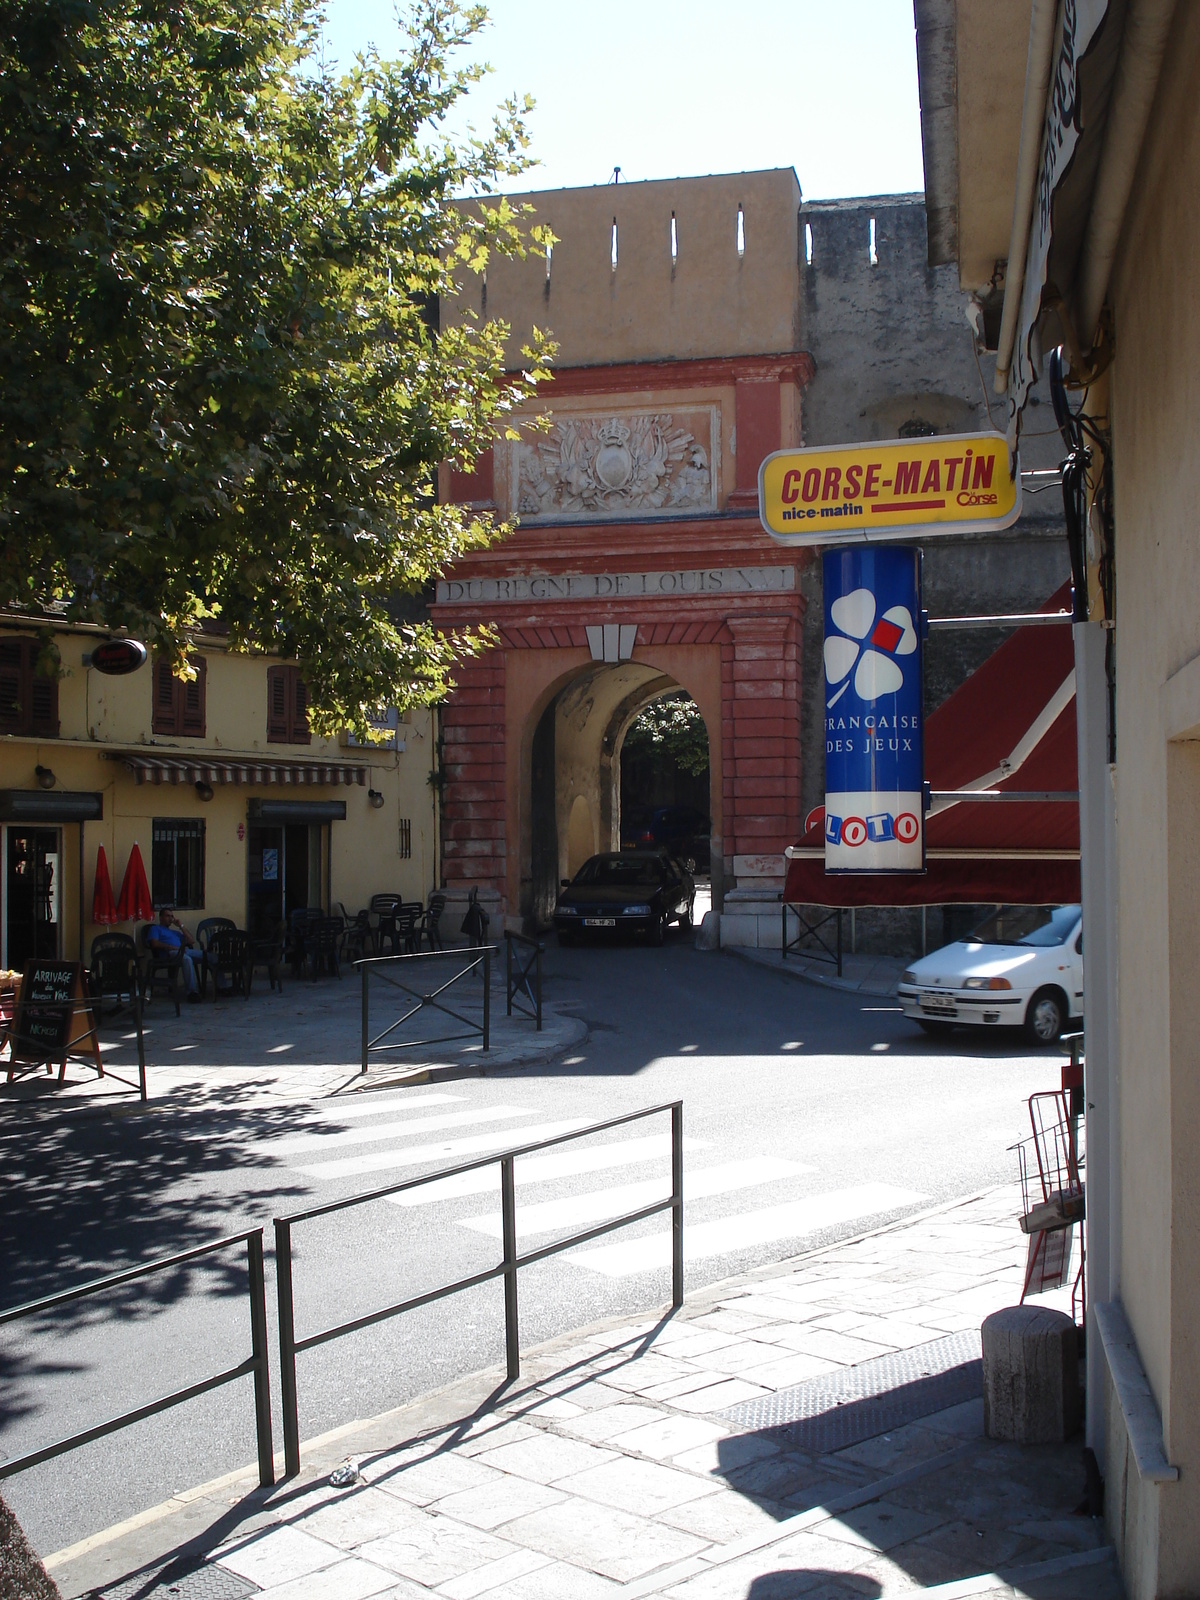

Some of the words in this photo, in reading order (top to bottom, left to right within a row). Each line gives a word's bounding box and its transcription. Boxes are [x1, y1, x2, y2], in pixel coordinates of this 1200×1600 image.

[781, 448, 995, 504] CORSE-MATIN
[446, 581, 483, 601] DU
[495, 577, 582, 599] REGNE
[594, 574, 630, 596] DE
[640, 571, 723, 593] LOUIS
[736, 569, 786, 590] XVI
[827, 739, 853, 753] DES
[863, 738, 912, 754] JEUX
[826, 813, 918, 846] LOTO
[33, 969, 72, 985] ARRIVAGE
